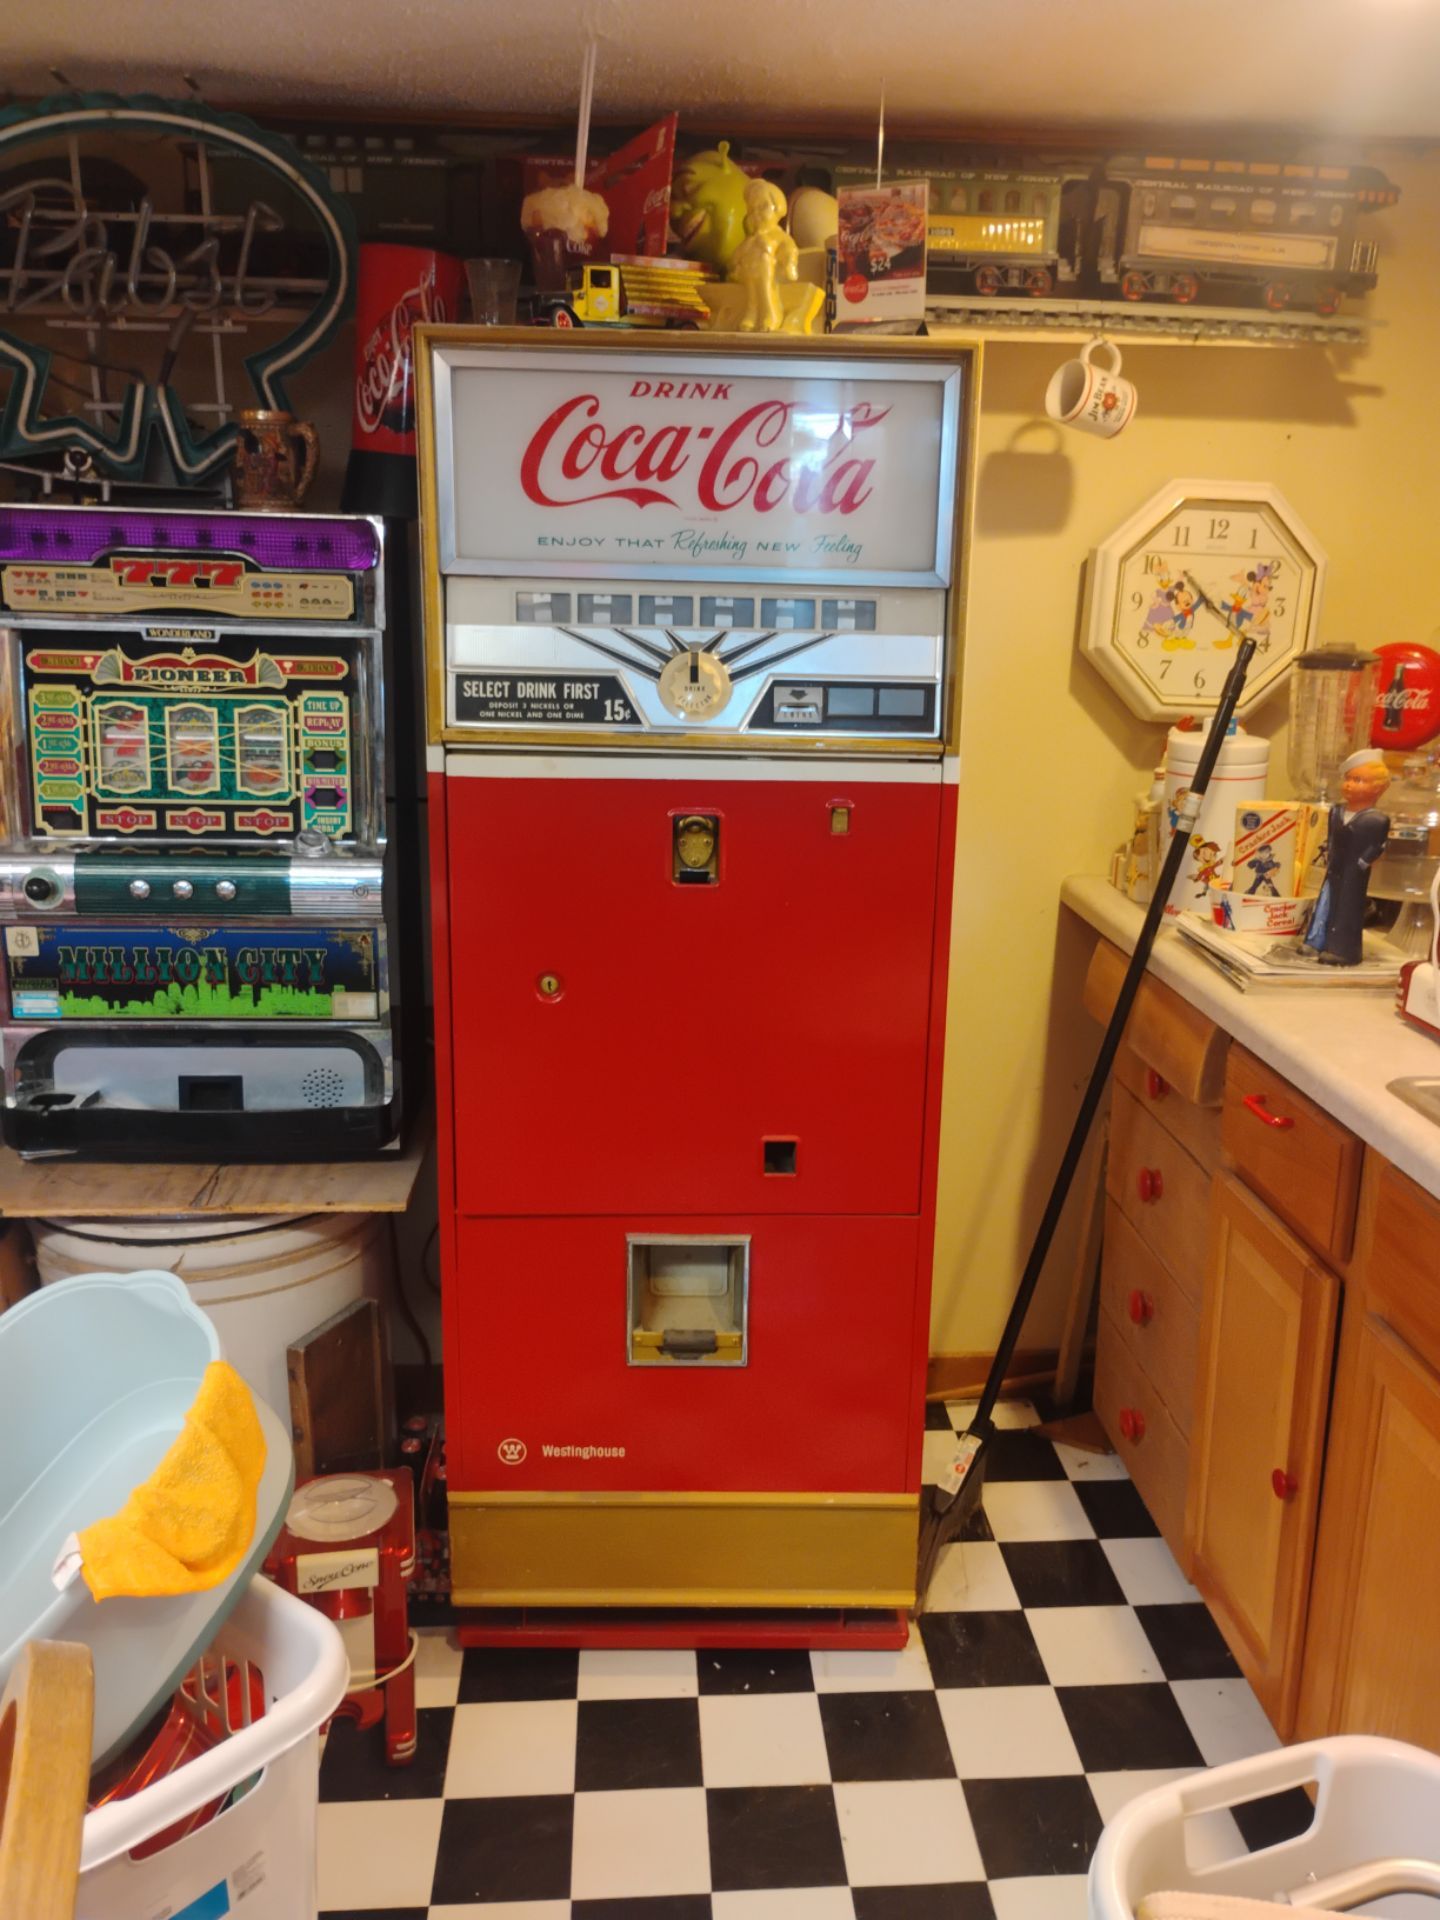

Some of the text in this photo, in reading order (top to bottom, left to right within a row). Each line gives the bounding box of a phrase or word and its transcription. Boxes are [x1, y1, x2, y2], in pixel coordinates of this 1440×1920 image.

[1134, 179, 1188, 189] CENTRAL
[1196, 183, 1254, 193] RAILROAD
[0, 178, 283, 314] Pabst
[870, 258, 892, 273] $24
[630, 380, 734, 400] DRINK
[520, 394, 894, 515] Coca-Cola
[1172, 526, 1191, 547] 11
[1207, 518, 1230, 540] 12
[1249, 528, 1258, 549] 1
[537, 529, 863, 562] ENJOY THAT Refreshing NEW Feeling
[1142, 554, 1162, 575] 10
[1270, 560, 1282, 579] 2
[1132, 591, 1143, 610] 9
[1273, 597, 1286, 617] 3
[149, 629, 212, 639] WONDERLAND
[1137, 632, 1149, 649] 8
[1258, 634, 1271, 653] 4
[134, 668, 246, 683] PIONEER
[1159, 659, 1172, 680] 7
[1193, 669, 1206, 689] 6
[463, 681, 600, 700] SELECT DRINK FIRST
[307, 700, 340, 711] TIME UP
[306, 717, 341, 729] REPLAY
[308, 739, 343, 748] BONUS
[106, 815, 148, 825] STOP
[174, 816, 217, 826] STOP
[242, 817, 285, 827] STOP
[1238, 832, 1271, 854] Cracker
[1270, 816, 1293, 834] Jack
[57, 946, 327, 985] MILLION CITY
[541, 1444, 626, 1460] Westinghouse
